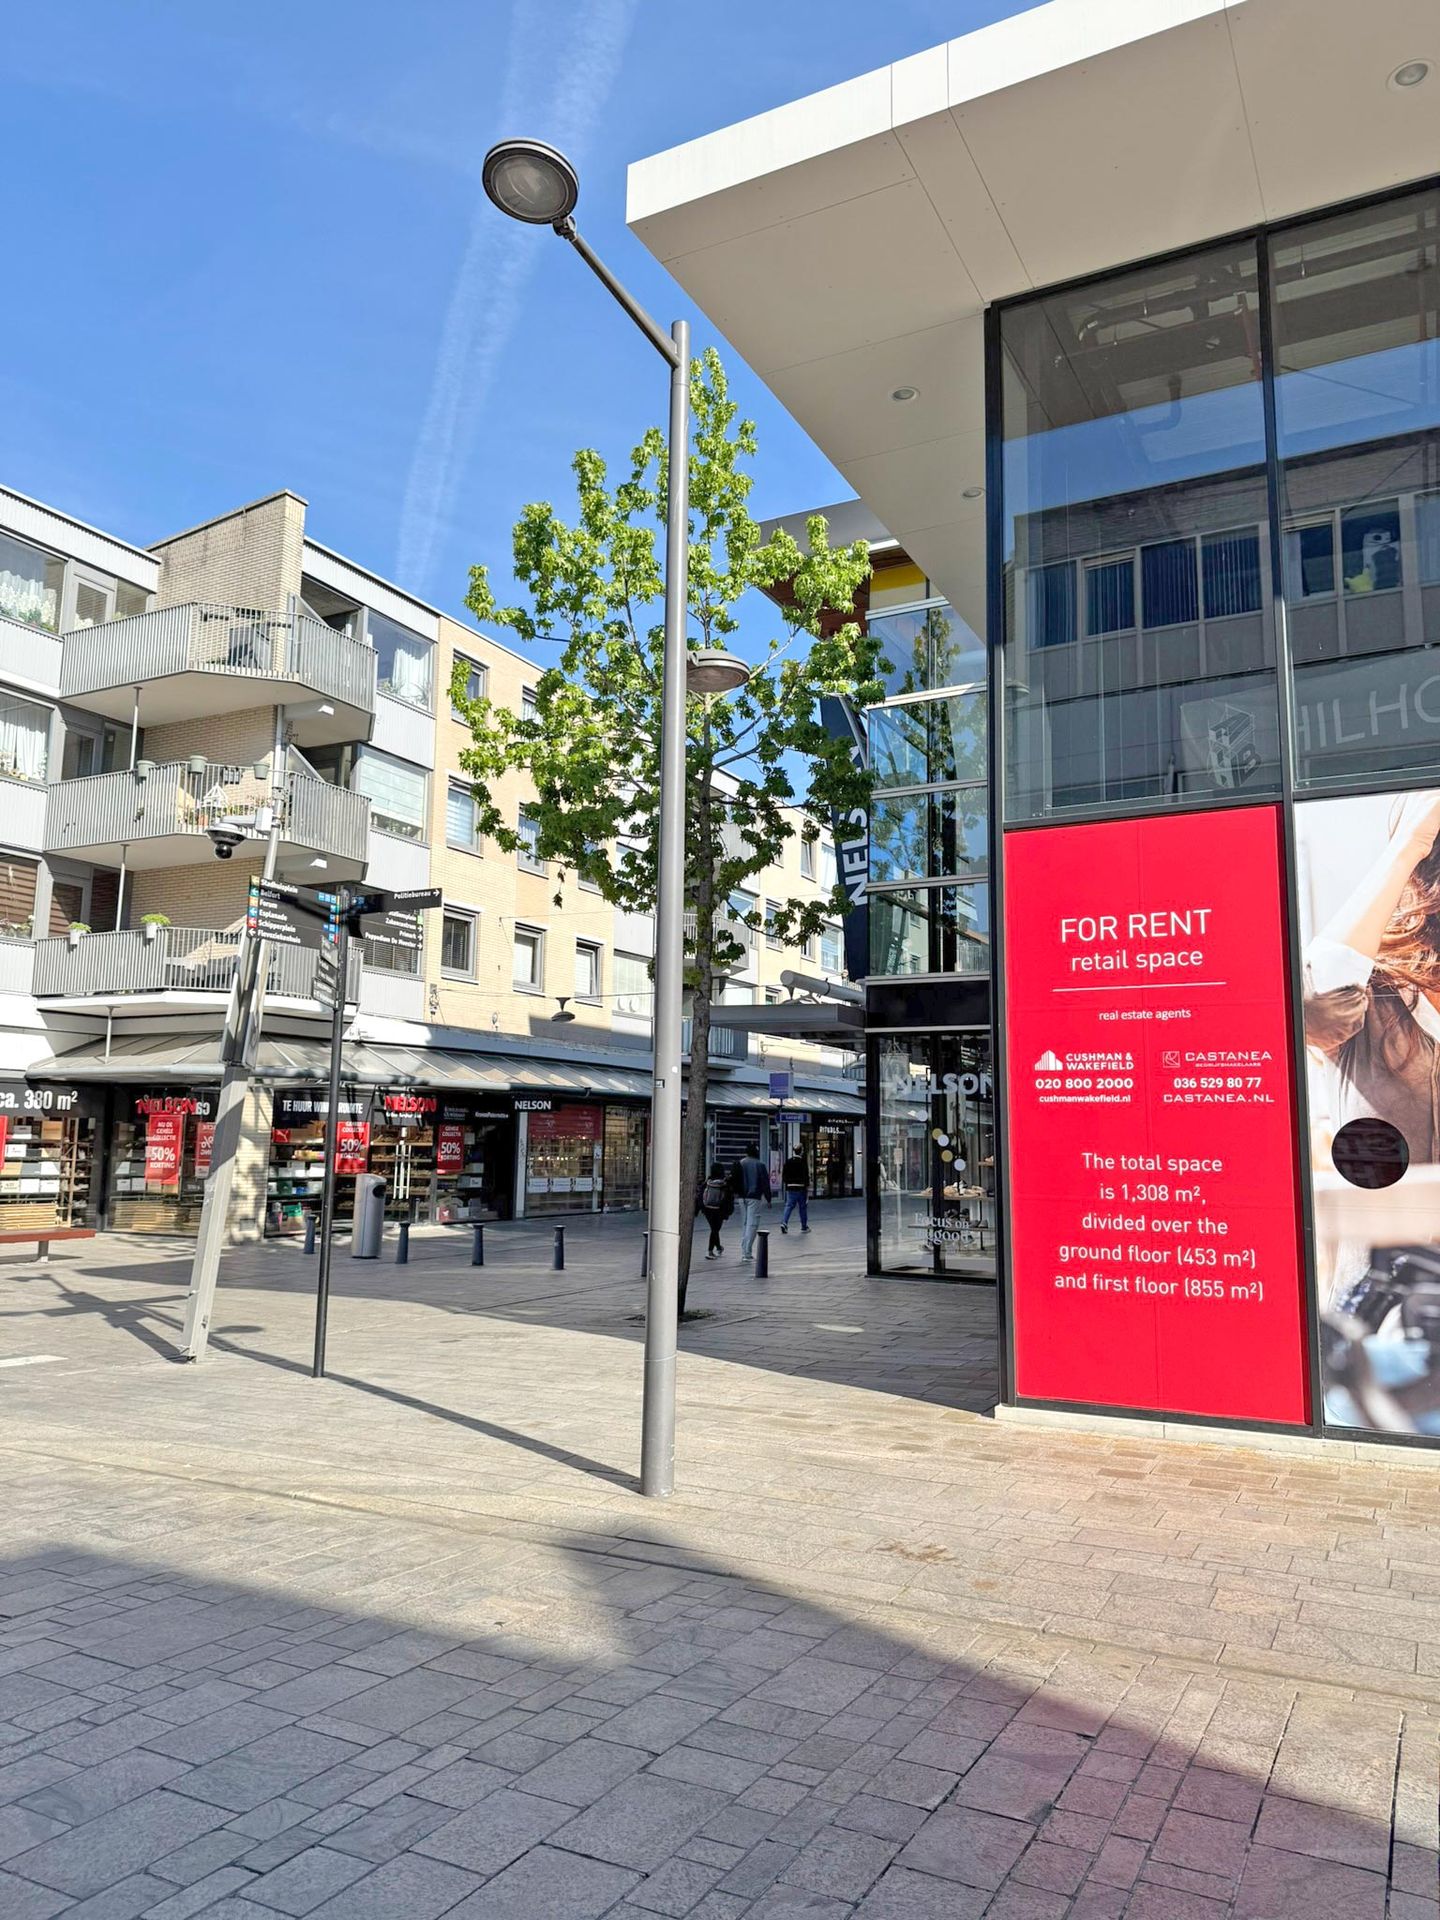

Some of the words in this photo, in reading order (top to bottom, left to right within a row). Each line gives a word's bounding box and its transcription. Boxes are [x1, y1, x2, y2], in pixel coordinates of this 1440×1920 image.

[260, 889, 281, 900] Belfort
[393, 890, 431, 900] Politiebureau
[259, 898, 278, 909] Forum
[258, 908, 288, 921] Esplanade
[1062, 916, 1117, 943] FOR
[1129, 909, 1212, 938] RENT
[1072, 950, 1129, 971] retail
[1136, 951, 1203, 973] space
[1099, 1011, 1118, 1020] real
[1121, 1011, 1153, 1019] estate
[1156, 1009, 1191, 1020] agents
[1066, 1053, 1122, 1062] CUSHMAN
[1125, 1052, 1133, 1061] &
[1185, 1051, 1272, 1061] CASTANEA
[1066, 1061, 1134, 1070] WAKEFIELD
[892, 1072, 992, 1095] NELSON
[1035, 1078, 1061, 1089] 020
[1065, 1078, 1092, 1089] 800
[1096, 1078, 1133, 1089] 2000
[1174, 1078, 1197, 1088] 036
[1200, 1078, 1223, 1088] 529
[1227, 1077, 1243, 1088] 80
[1245, 1077, 1261, 1088] 77
[24, 1090, 53, 1110] 380
[57, 1090, 78, 1110] m²
[384, 1095, 438, 1112] NELSON
[1164, 1094, 1274, 1102] CASTANEA.NL
[135, 1097, 197, 1115] NELSON
[282, 1100, 292, 1112] TE
[292, 1100, 313, 1113] HUUR
[514, 1100, 552, 1110] NELSON
[150, 1147, 176, 1161] 50%
[441, 1142, 461, 1154] 50%
[1082, 1153, 1115, 1169] The
[1121, 1155, 1162, 1170] total
[1168, 1159, 1222, 1175] space
[1100, 1184, 1115, 1199] is
[1122, 1184, 1169, 1202] 1,308
[1176, 1186, 1205, 1204] m²,
[914, 1212, 952, 1229] Focus
[955, 1220, 970, 1229] on
[1082, 1213, 1145, 1231] divided
[1151, 1220, 1192, 1232] over
[1197, 1217, 1227, 1234] the
[1060, 1245, 1122, 1262] ground
[1128, 1246, 1171, 1263] floor
[1178, 1246, 1216, 1265] (453
[1224, 1249, 1255, 1269] m²)
[1055, 1273, 1086, 1289] and
[1093, 1274, 1129, 1291] first
[1135, 1276, 1178, 1294] floor
[1185, 1278, 1224, 1297] (855
[1231, 1281, 1263, 1301] m²)
